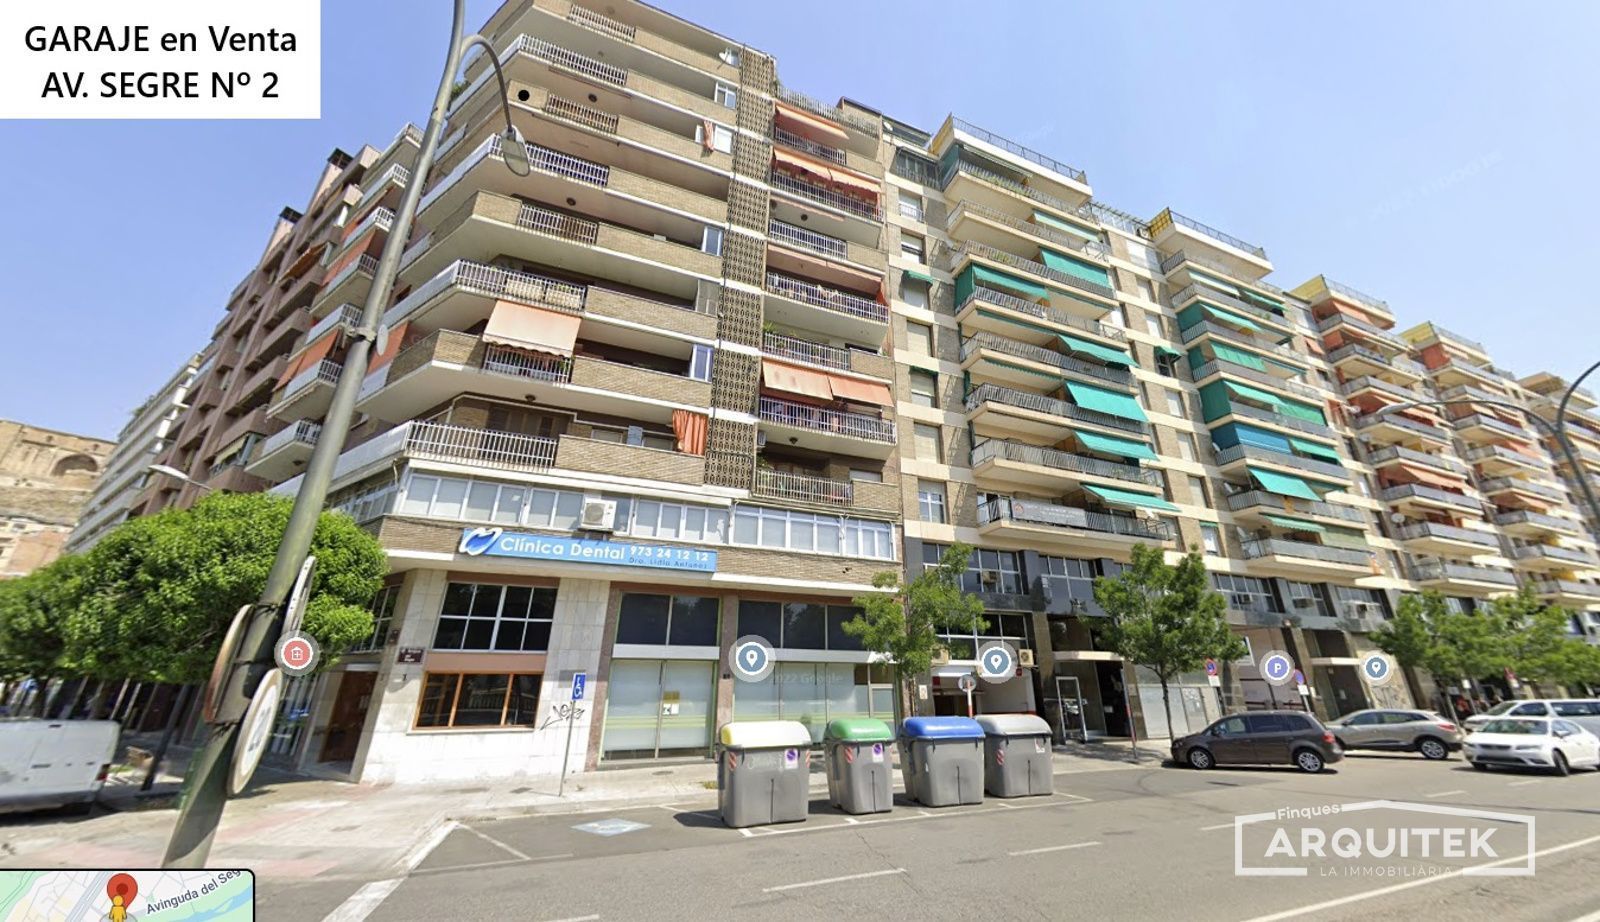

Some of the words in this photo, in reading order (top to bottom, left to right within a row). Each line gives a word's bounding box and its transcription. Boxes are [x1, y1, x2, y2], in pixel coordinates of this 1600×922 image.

[500, 536, 564, 555] Clínica
[569, 543, 625, 560] Dental
[629, 545, 653, 557] 973
[656, 548, 672, 559] 24
[677, 550, 690, 560] 12
[695, 552, 709, 561] 12
